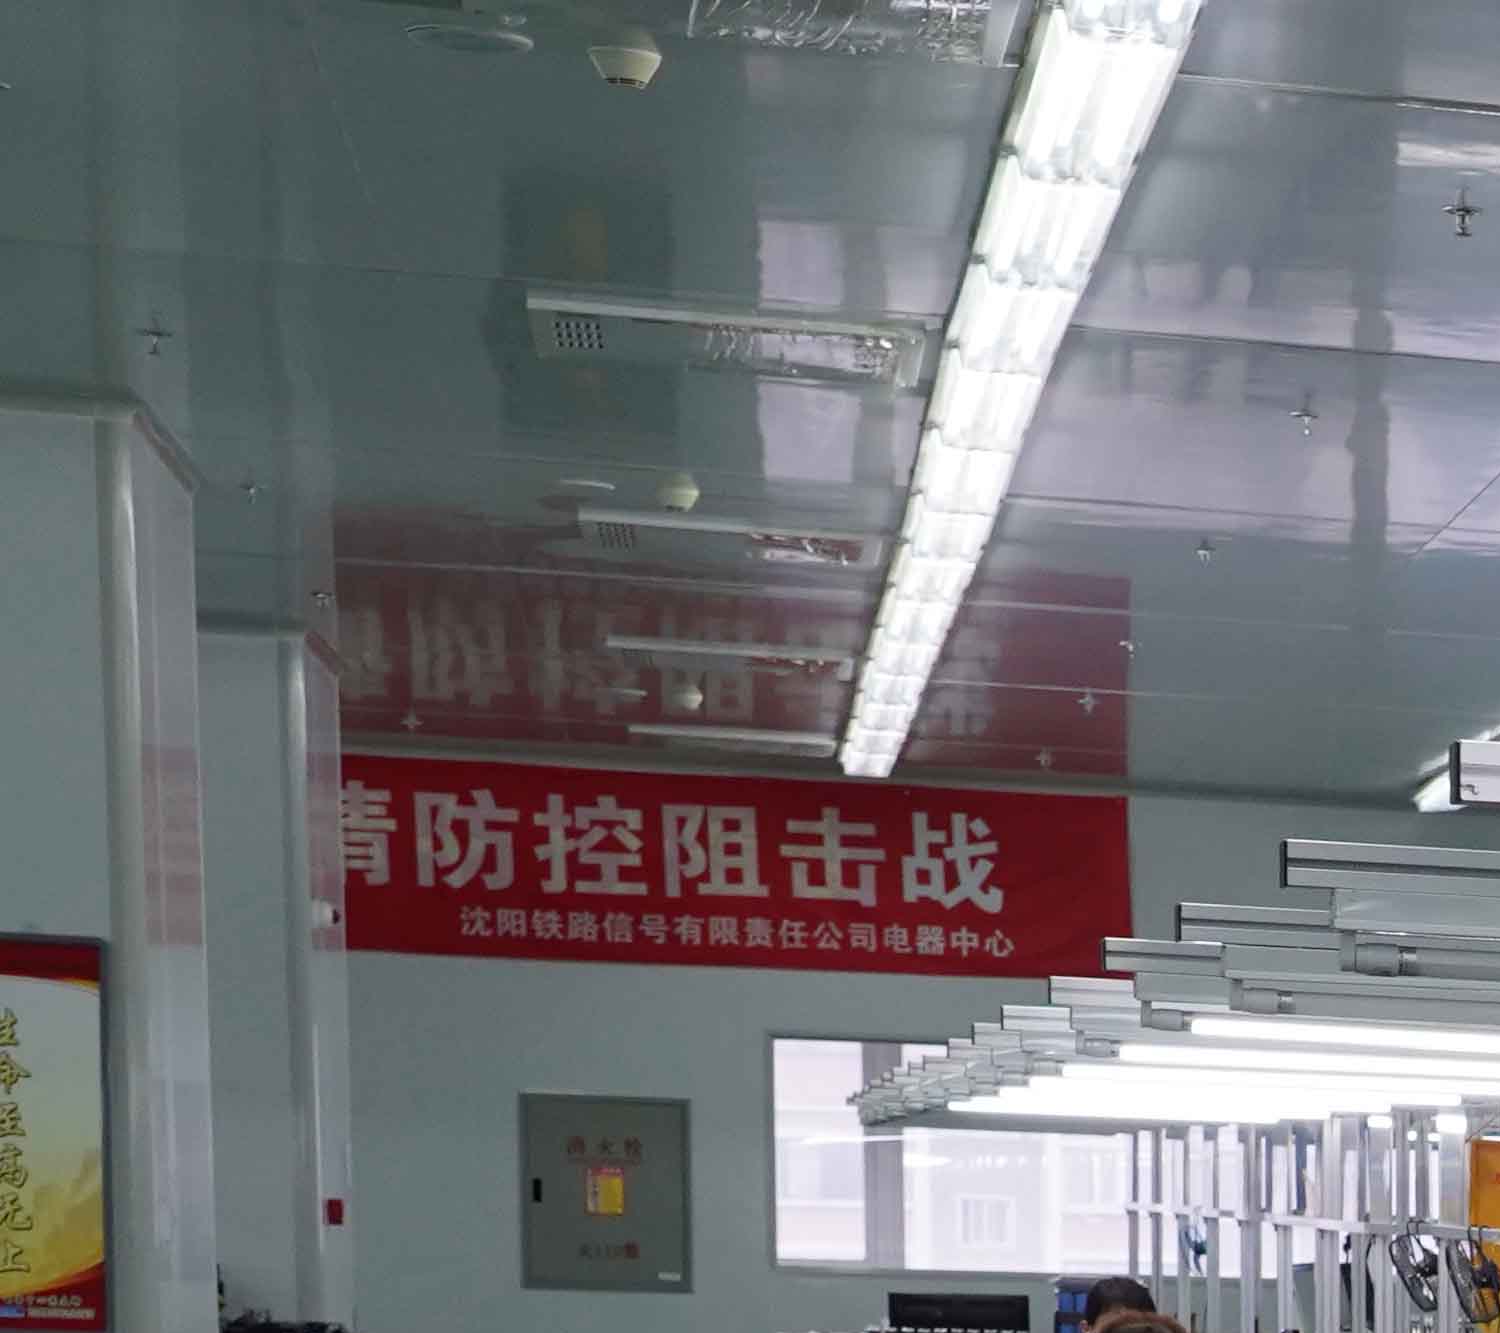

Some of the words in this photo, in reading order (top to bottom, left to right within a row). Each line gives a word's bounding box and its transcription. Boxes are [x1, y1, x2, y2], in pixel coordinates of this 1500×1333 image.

[460, 904, 1015, 957] 沈阳铁路信号有限责任公司电器中心
